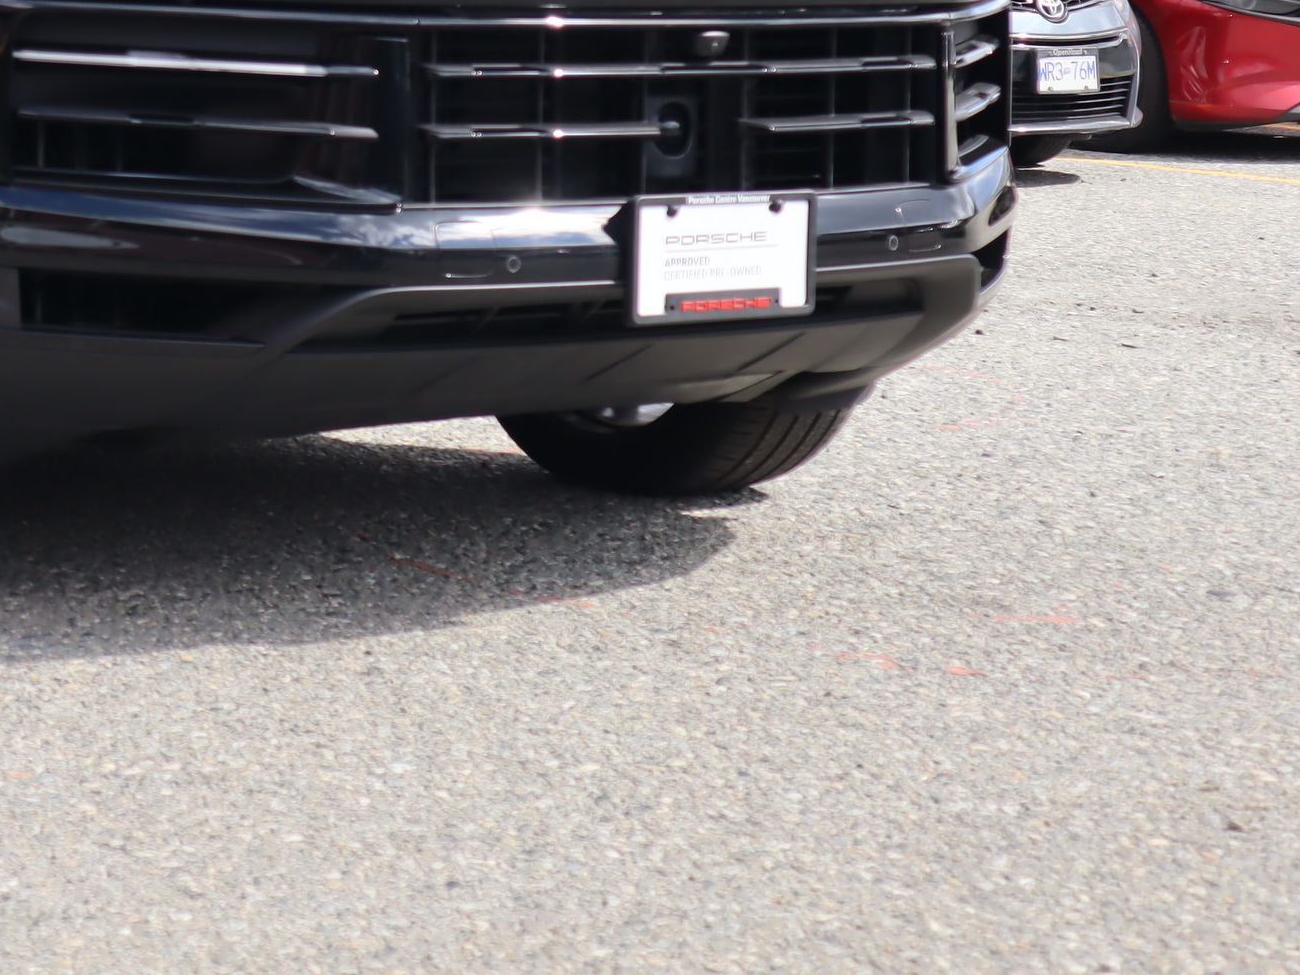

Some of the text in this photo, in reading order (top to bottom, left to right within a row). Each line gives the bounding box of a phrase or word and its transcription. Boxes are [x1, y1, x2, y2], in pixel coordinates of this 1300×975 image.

[688, 193, 771, 205] Porsche Centre Vancouver
[665, 231, 768, 246] PORSCHE
[664, 256, 710, 267] APPROVED
[680, 296, 772, 314] PORSCHE
